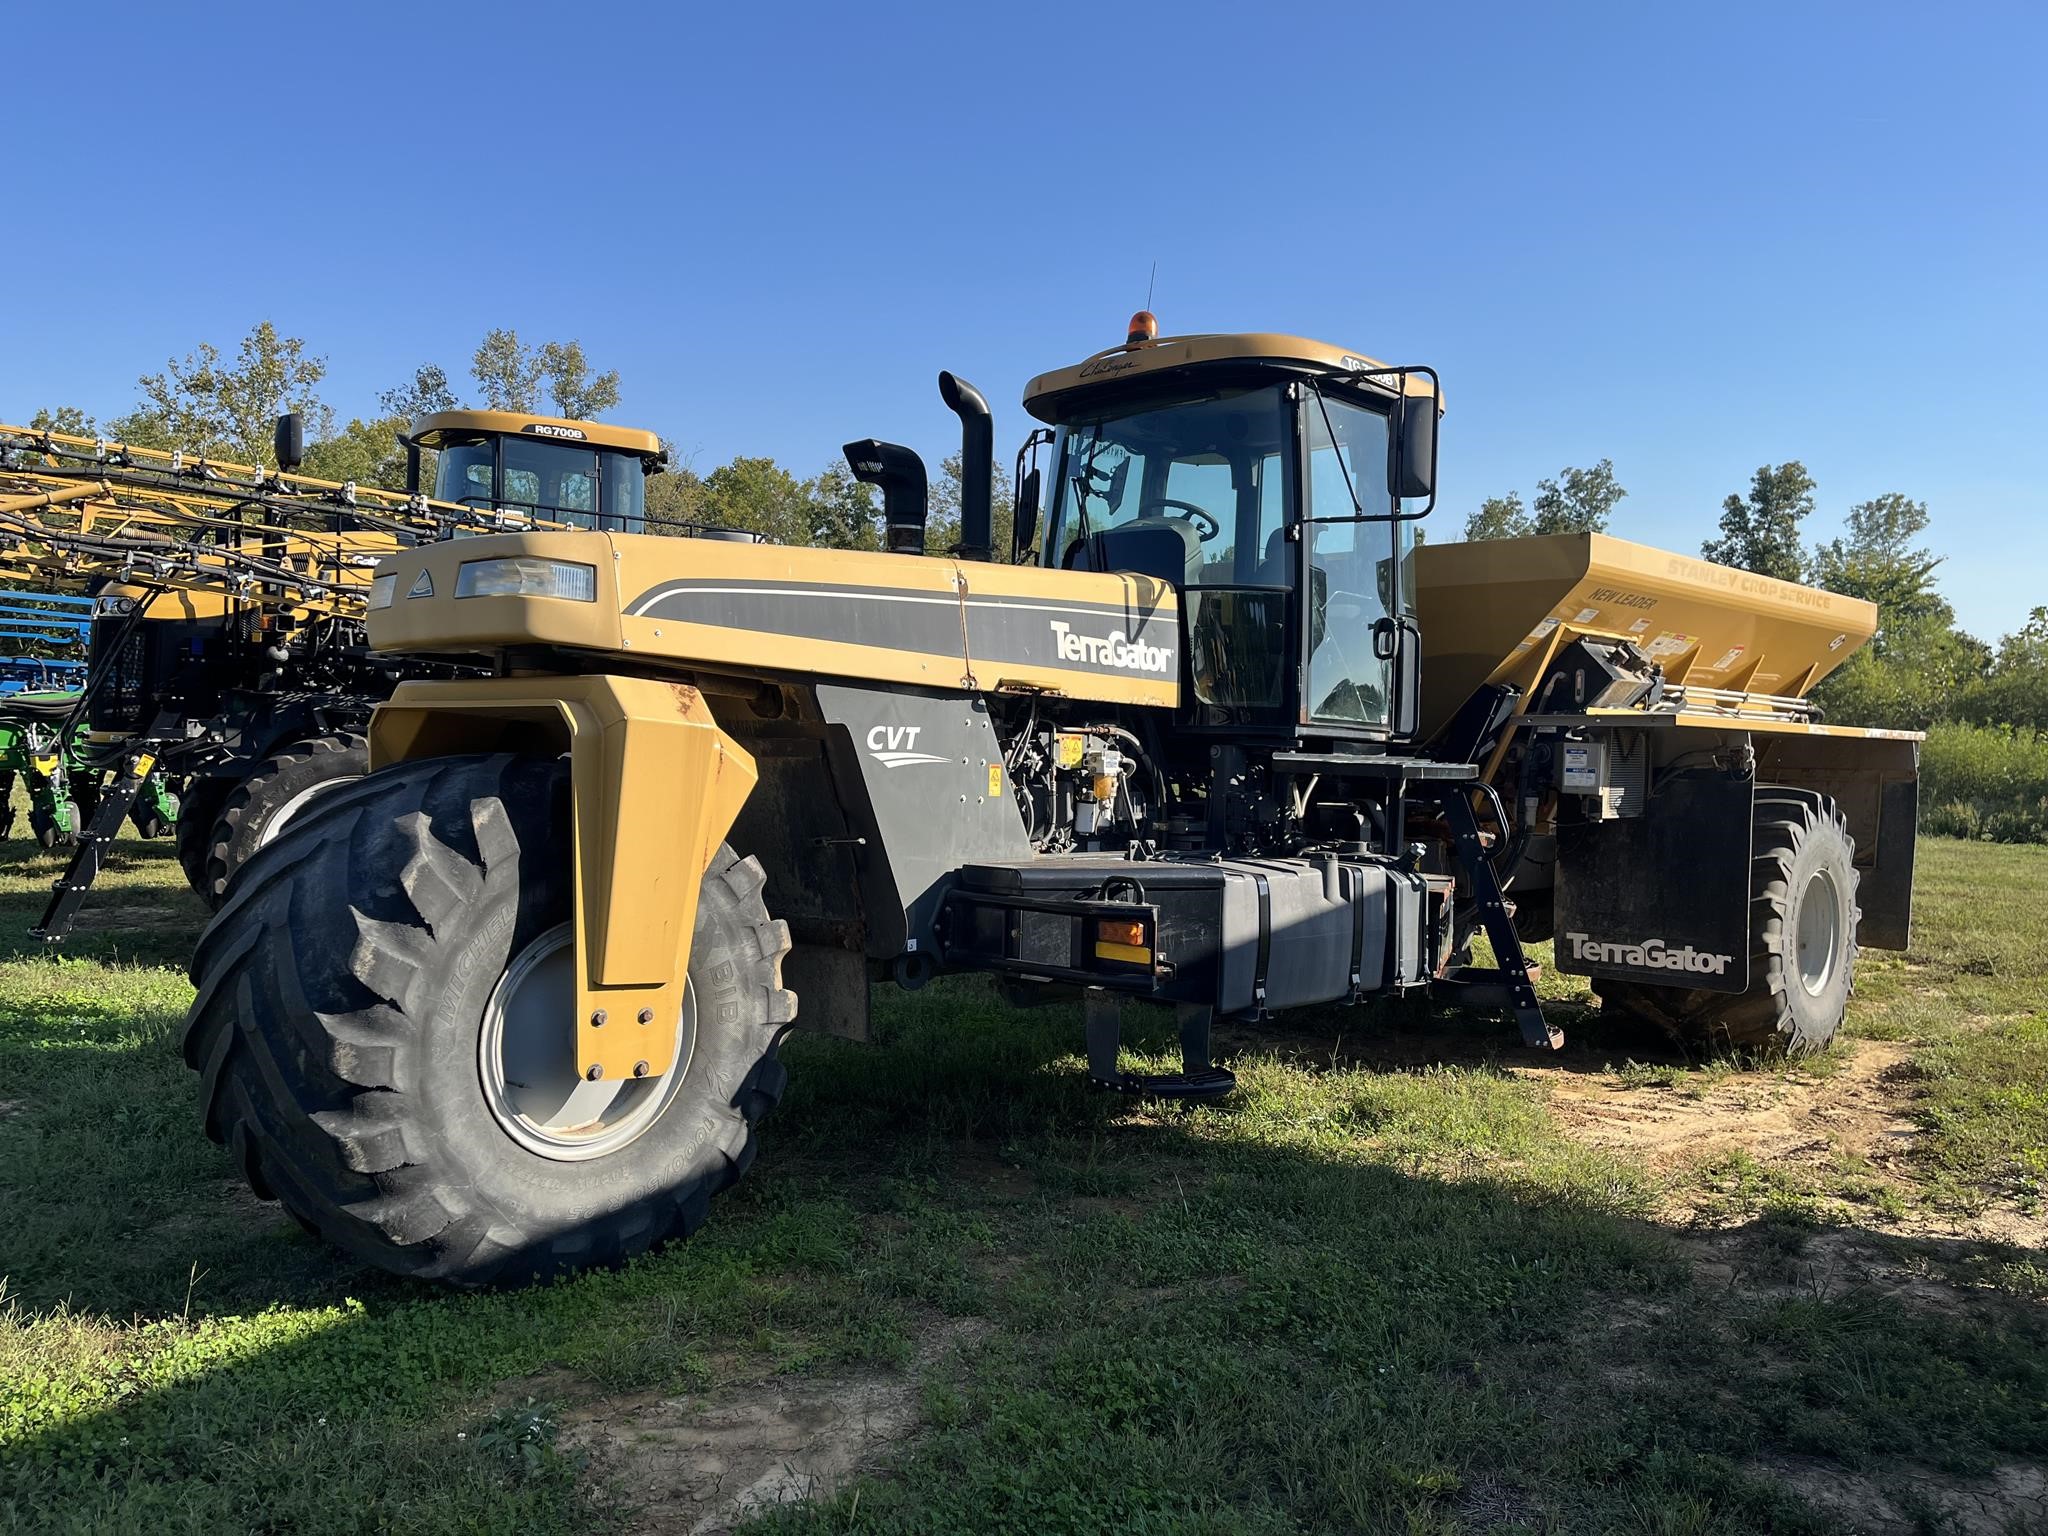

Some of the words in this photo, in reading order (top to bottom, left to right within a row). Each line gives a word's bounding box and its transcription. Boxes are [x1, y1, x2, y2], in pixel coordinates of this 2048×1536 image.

[535, 425, 582, 438] RG700B
[1588, 587, 1620, 603] NEW
[1614, 592, 1658, 610] LEADER
[1667, 559, 1738, 588] STANLEY
[1741, 577, 1777, 596] CROP
[1779, 587, 1832, 609] SERVICE
[1050, 620, 1172, 673] TerraGator
[866, 725, 921, 751] CVT
[438, 903, 516, 1026] MICHEL
[1566, 932, 1732, 975] TerraGator
